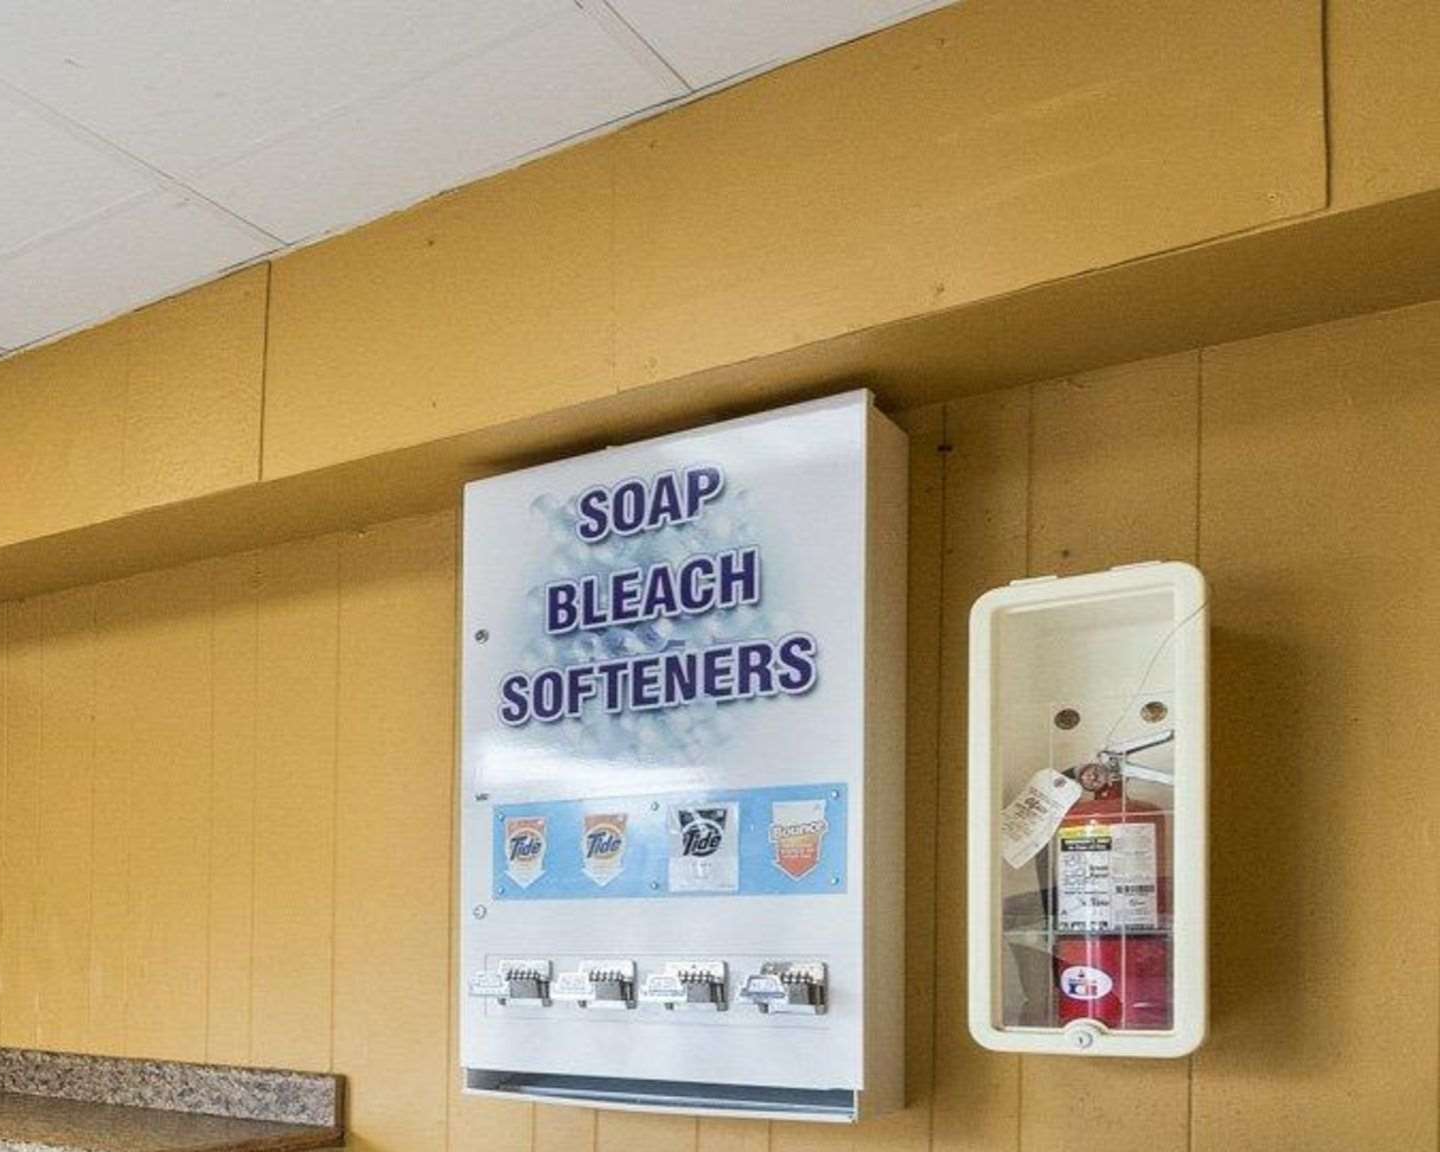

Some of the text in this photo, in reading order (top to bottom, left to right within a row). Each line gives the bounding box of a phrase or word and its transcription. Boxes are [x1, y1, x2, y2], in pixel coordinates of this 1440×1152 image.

[578, 466, 723, 540] SOAP
[547, 549, 759, 632] BLEACH
[500, 635, 817, 725] SOFTENERS
[510, 835, 541, 861] Tide
[586, 831, 621, 858] Tide
[682, 826, 722, 856] Tide
